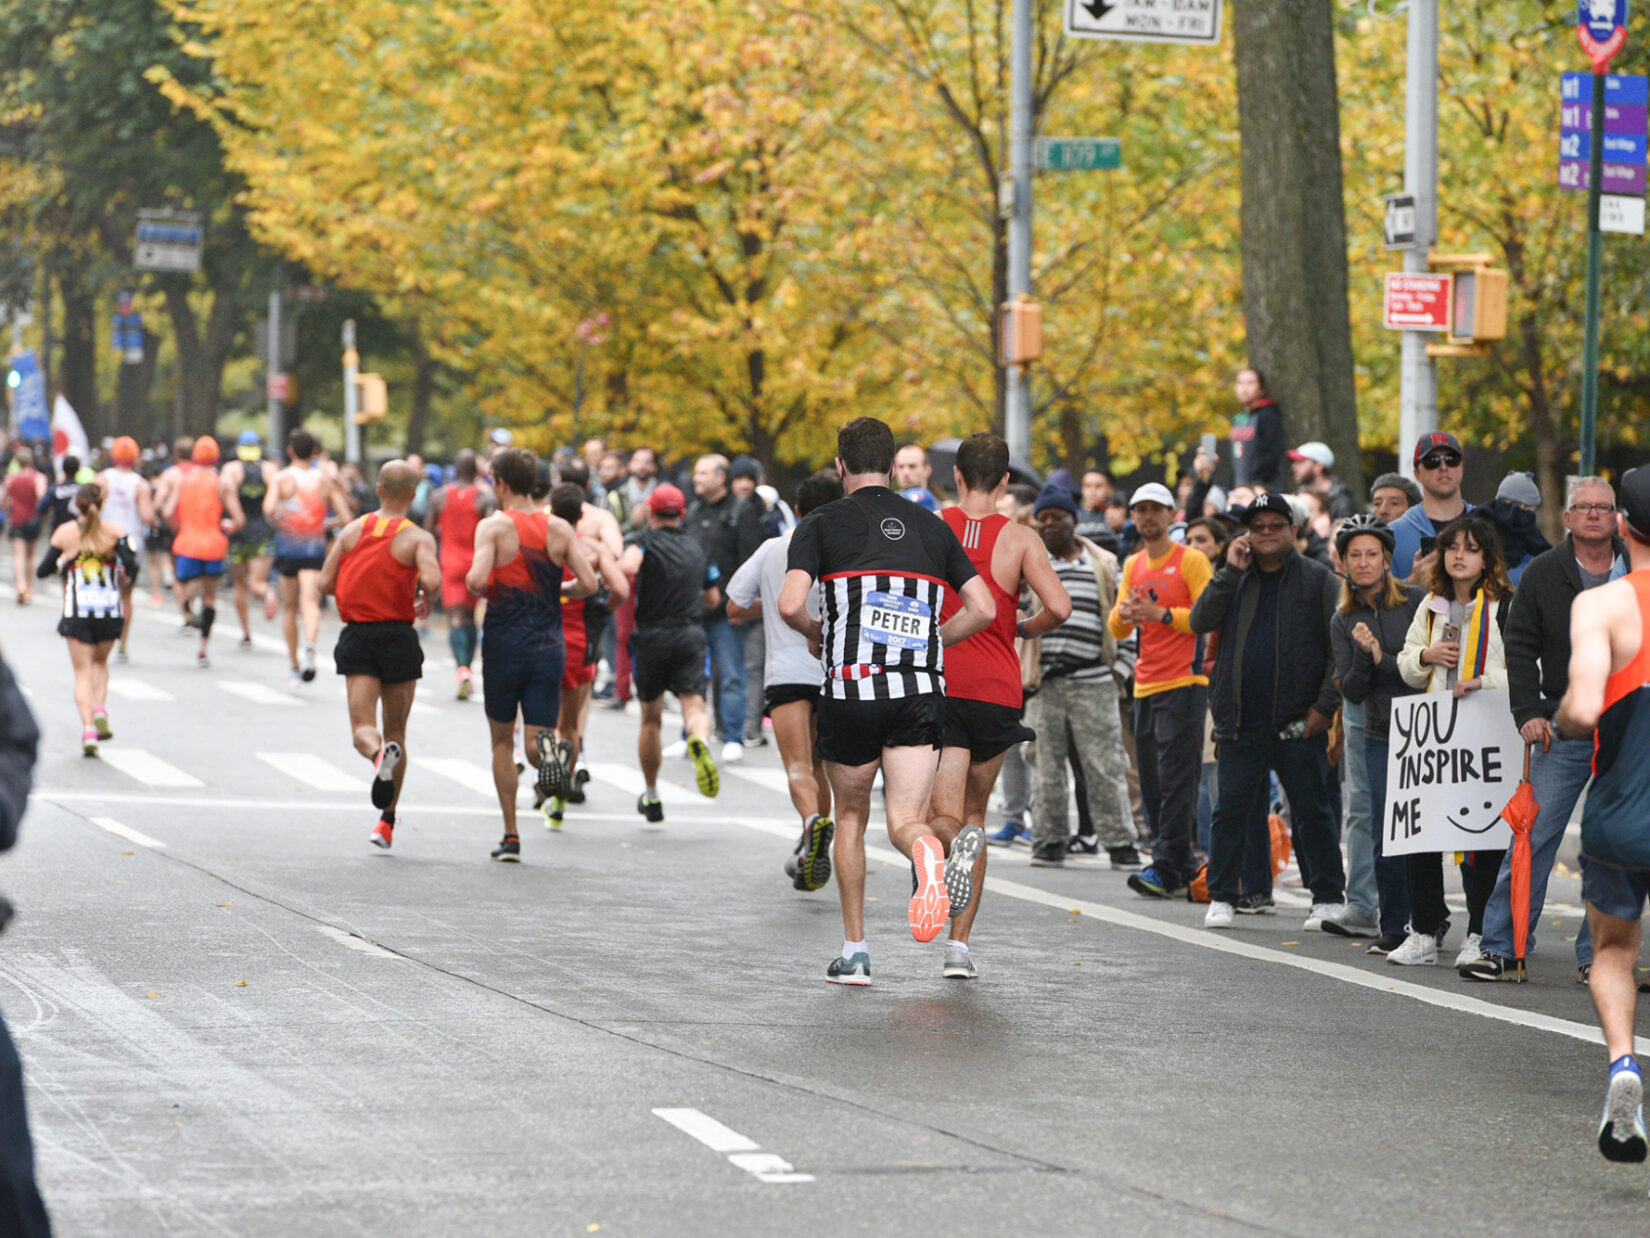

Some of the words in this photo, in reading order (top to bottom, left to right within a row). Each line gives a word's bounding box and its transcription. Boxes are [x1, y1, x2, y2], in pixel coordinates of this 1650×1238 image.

[1125, 14, 1161, 29] MON
[1178, 15, 1206, 32] FRI
[871, 609, 921, 635] PETER
[887, 635, 907, 645] 2017
[1395, 697, 1459, 760] YOU
[1399, 746, 1502, 789] INSPIRE
[1390, 797, 1422, 841] ME
